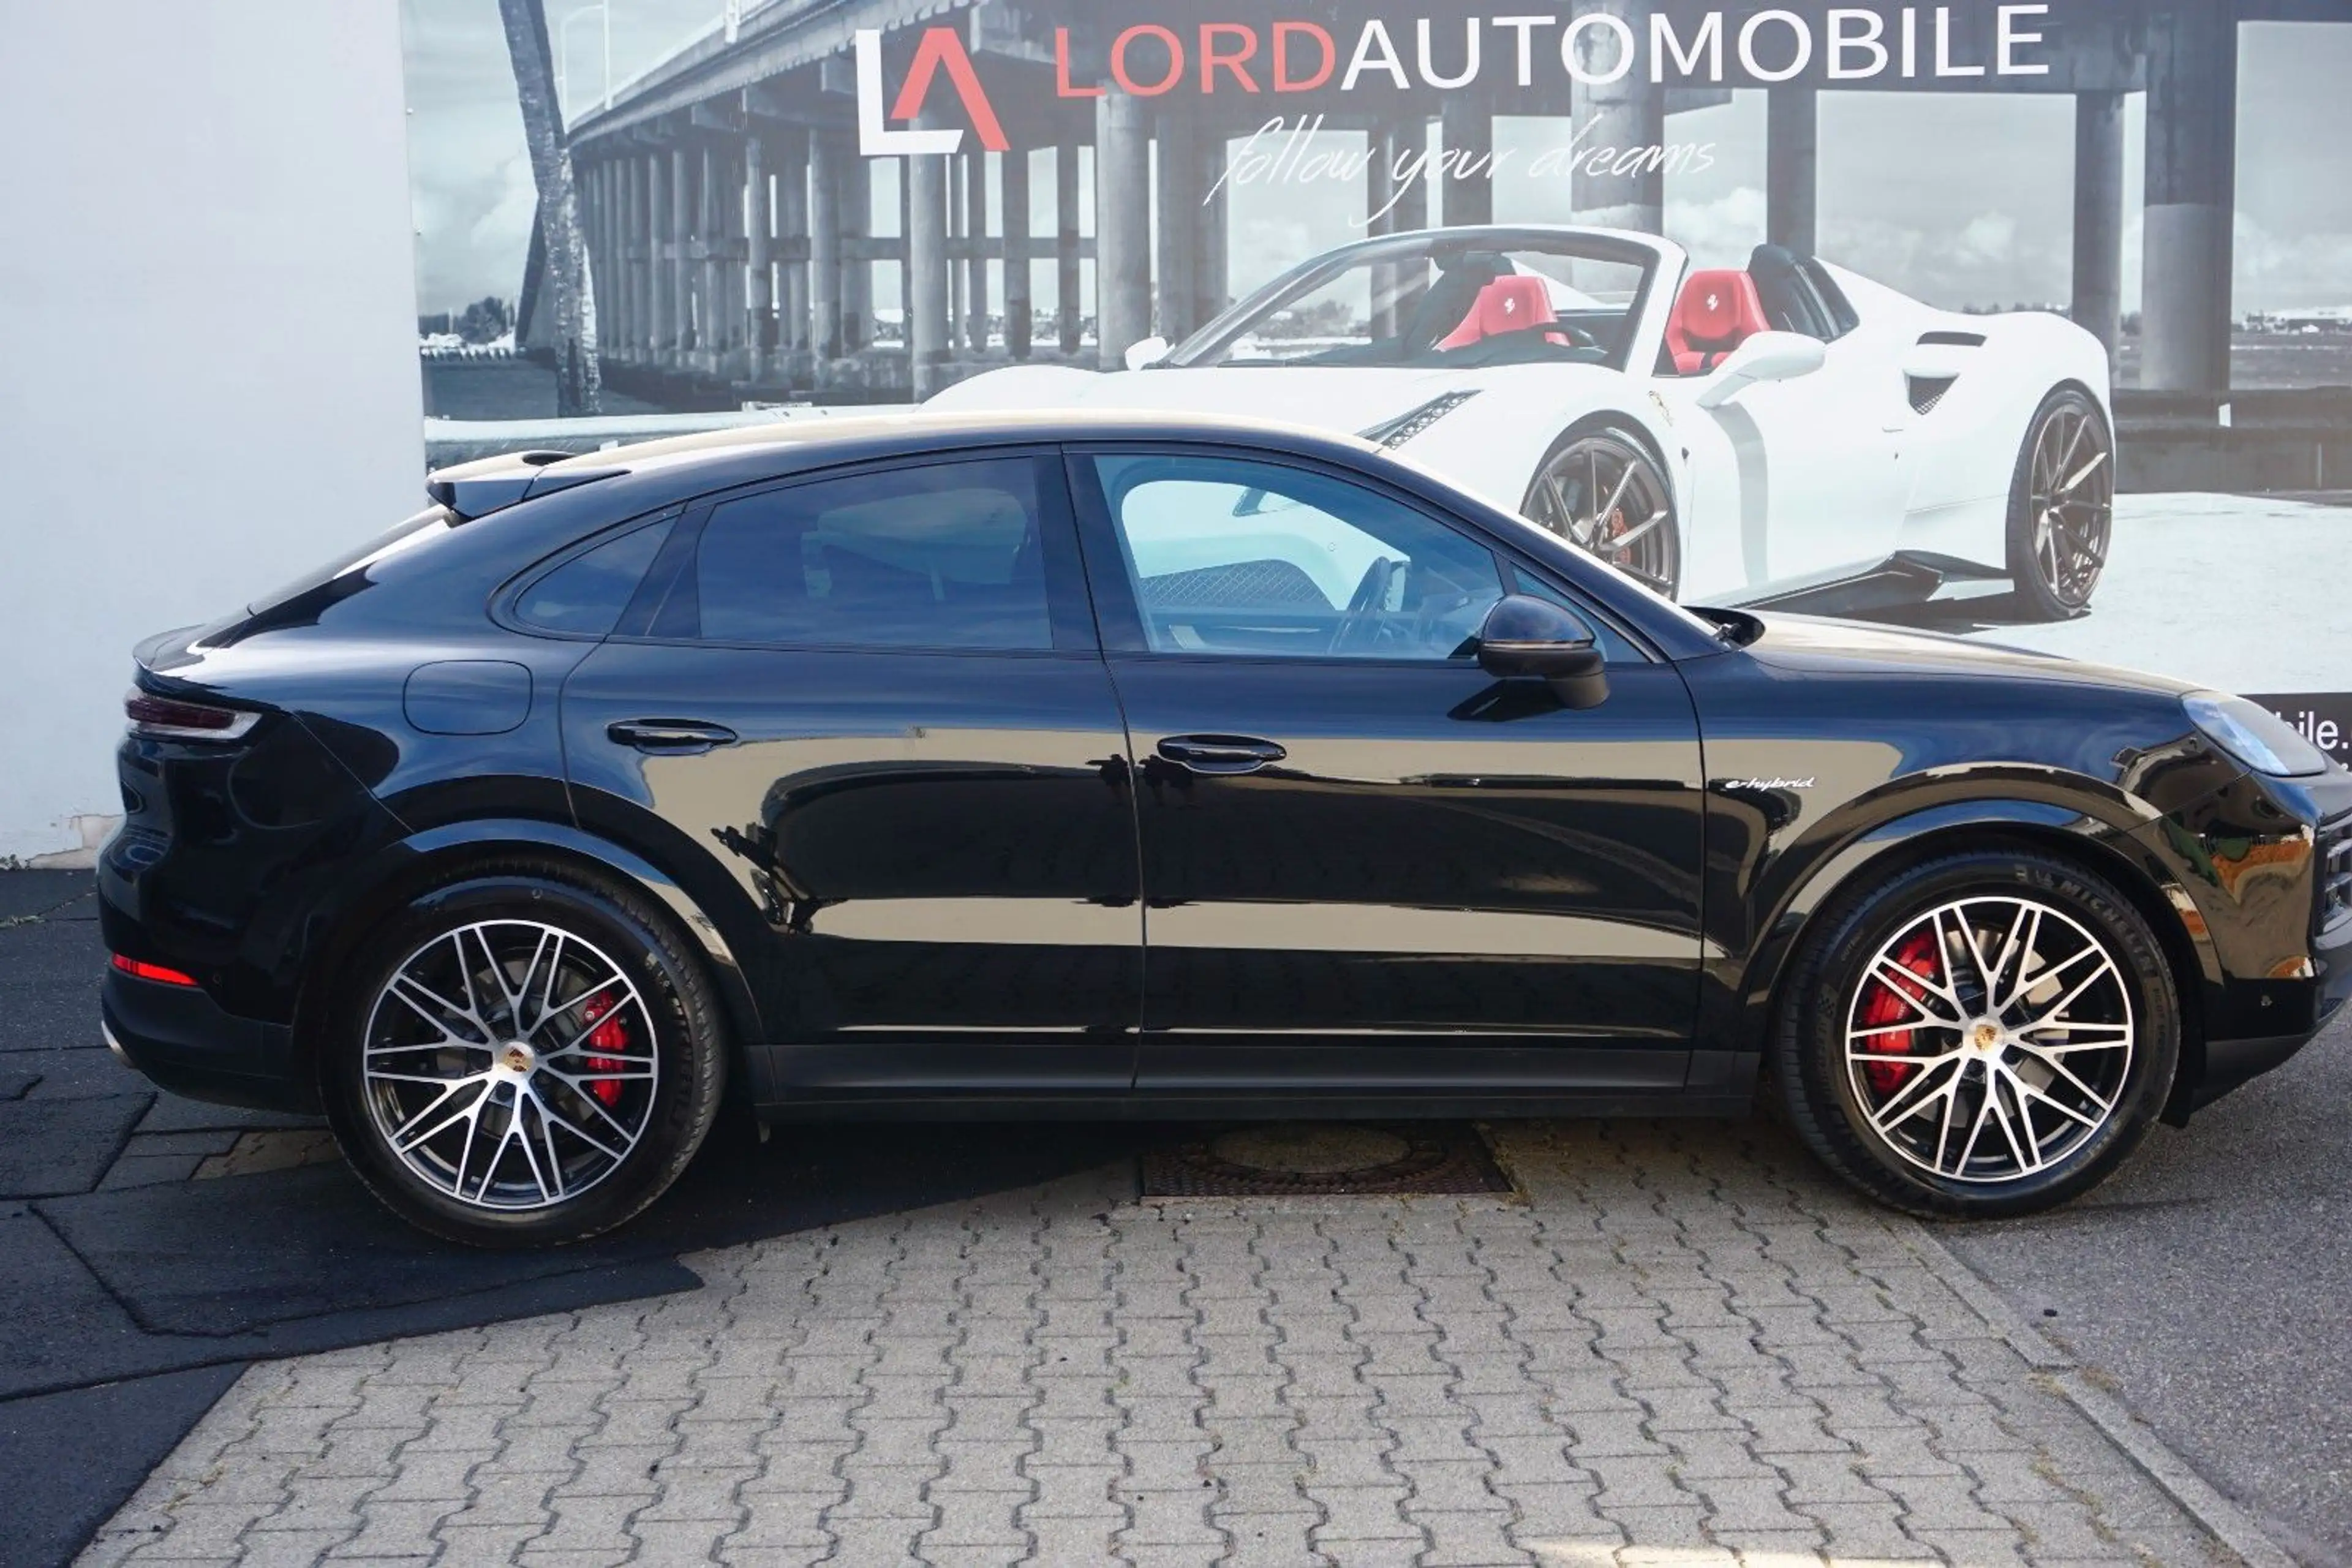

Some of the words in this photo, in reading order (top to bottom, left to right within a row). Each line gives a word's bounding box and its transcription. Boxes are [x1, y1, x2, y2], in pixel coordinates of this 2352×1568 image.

[1204, 113, 1376, 207] follow
[1348, 133, 1517, 227] your
[1528, 113, 1716, 178] dreams
[1725, 777, 1815, 791] e-hybrid
